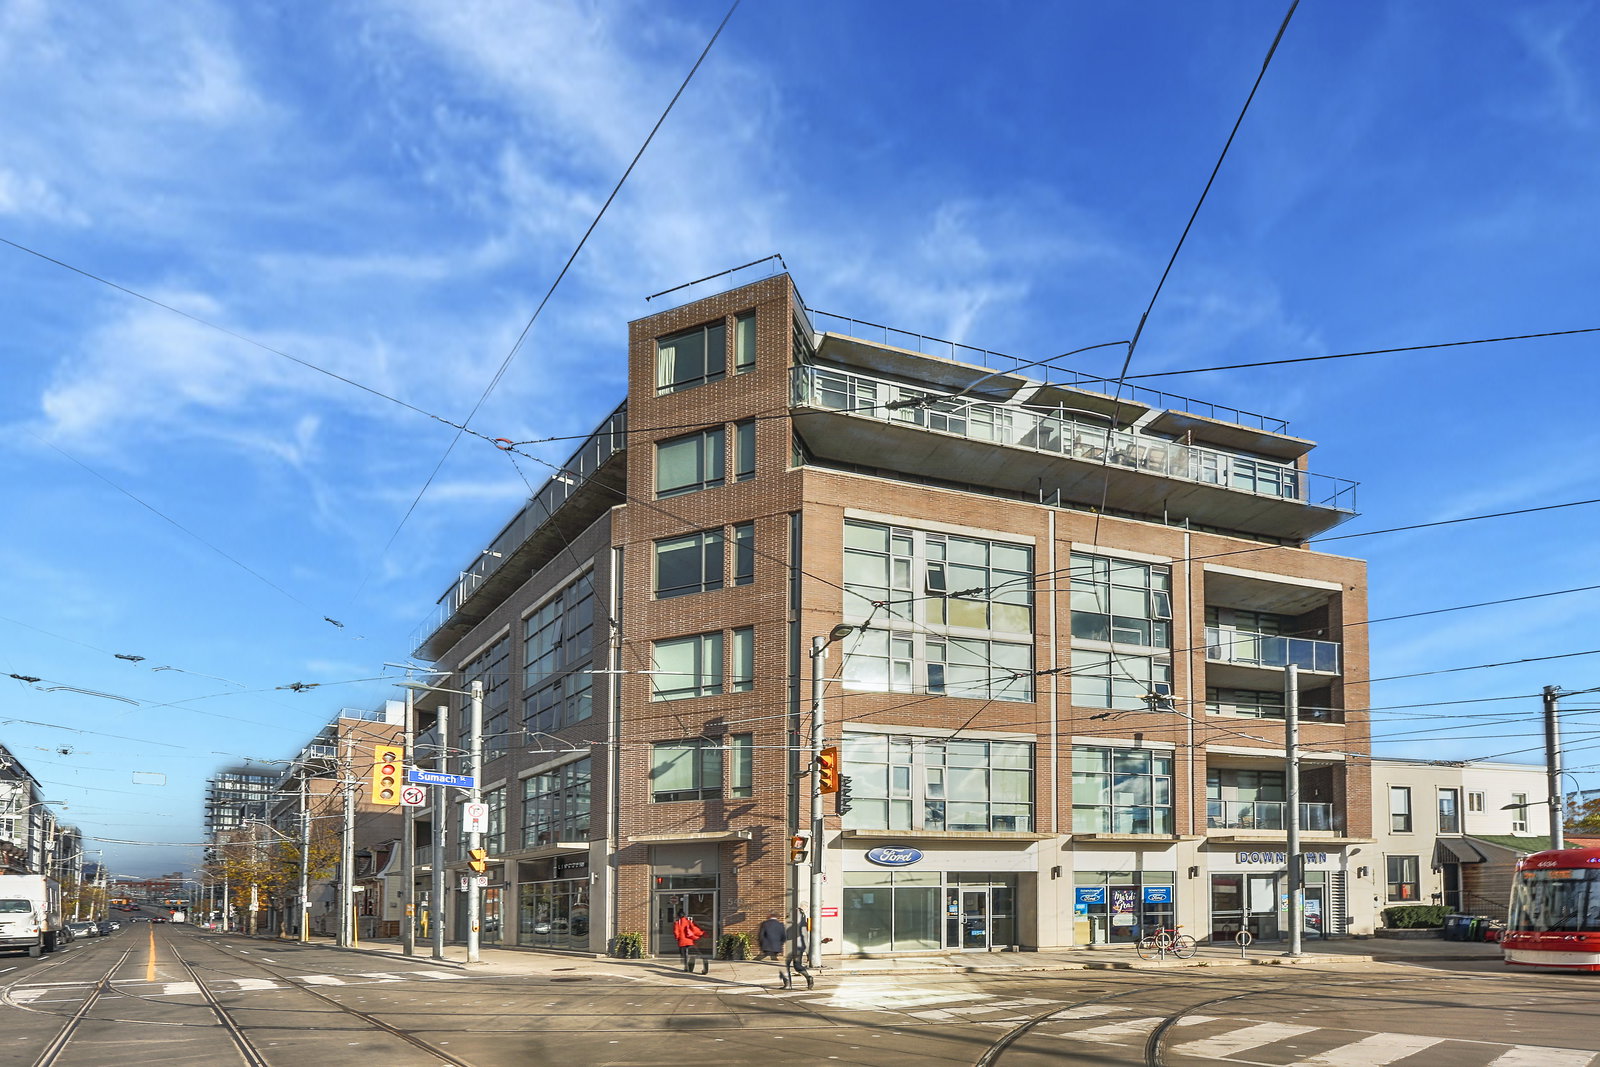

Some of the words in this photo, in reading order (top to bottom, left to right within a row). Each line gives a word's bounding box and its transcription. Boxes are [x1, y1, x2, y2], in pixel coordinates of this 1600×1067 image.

[417, 772, 457, 784] Sumach
[880, 848, 912, 861] Ford
[1240, 852, 1327, 863] DOWNWN
